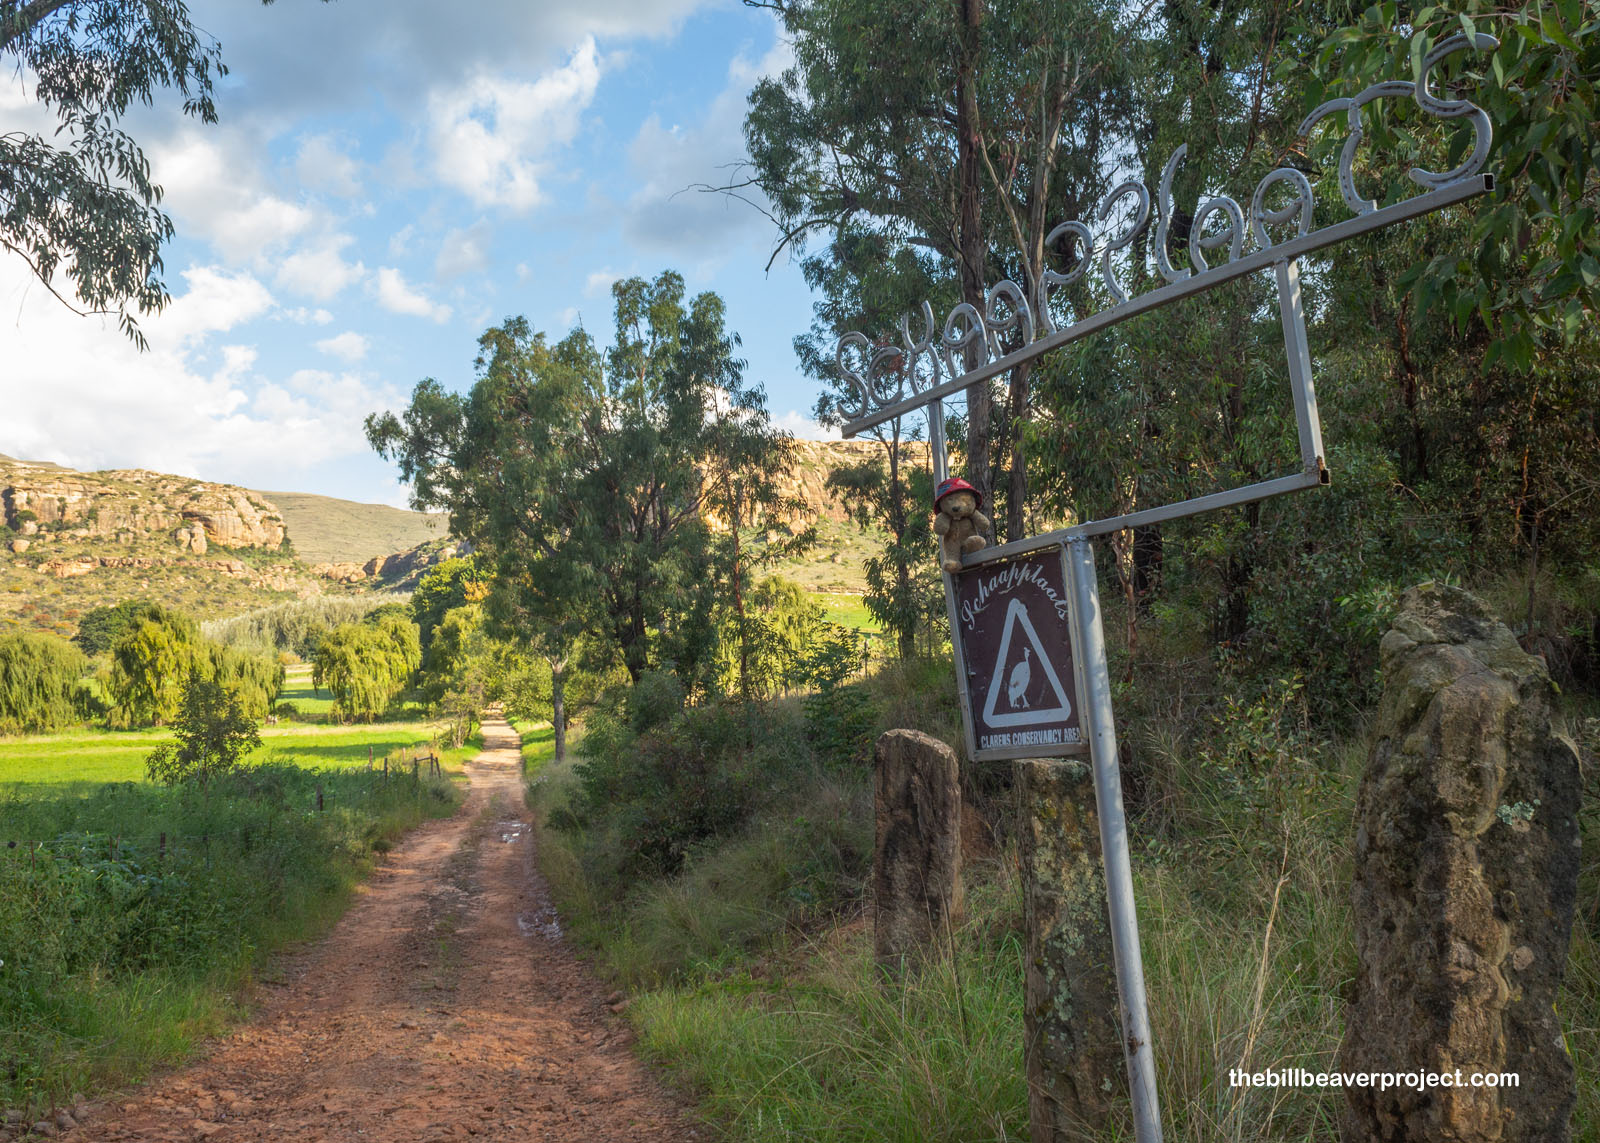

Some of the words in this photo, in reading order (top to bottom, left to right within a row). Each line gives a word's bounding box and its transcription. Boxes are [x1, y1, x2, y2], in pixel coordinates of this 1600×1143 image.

[961, 562, 1068, 631] Schaapplaats
[981, 733, 1011, 749] CLARENS
[1012, 728, 1062, 746] CONSERVANCY
